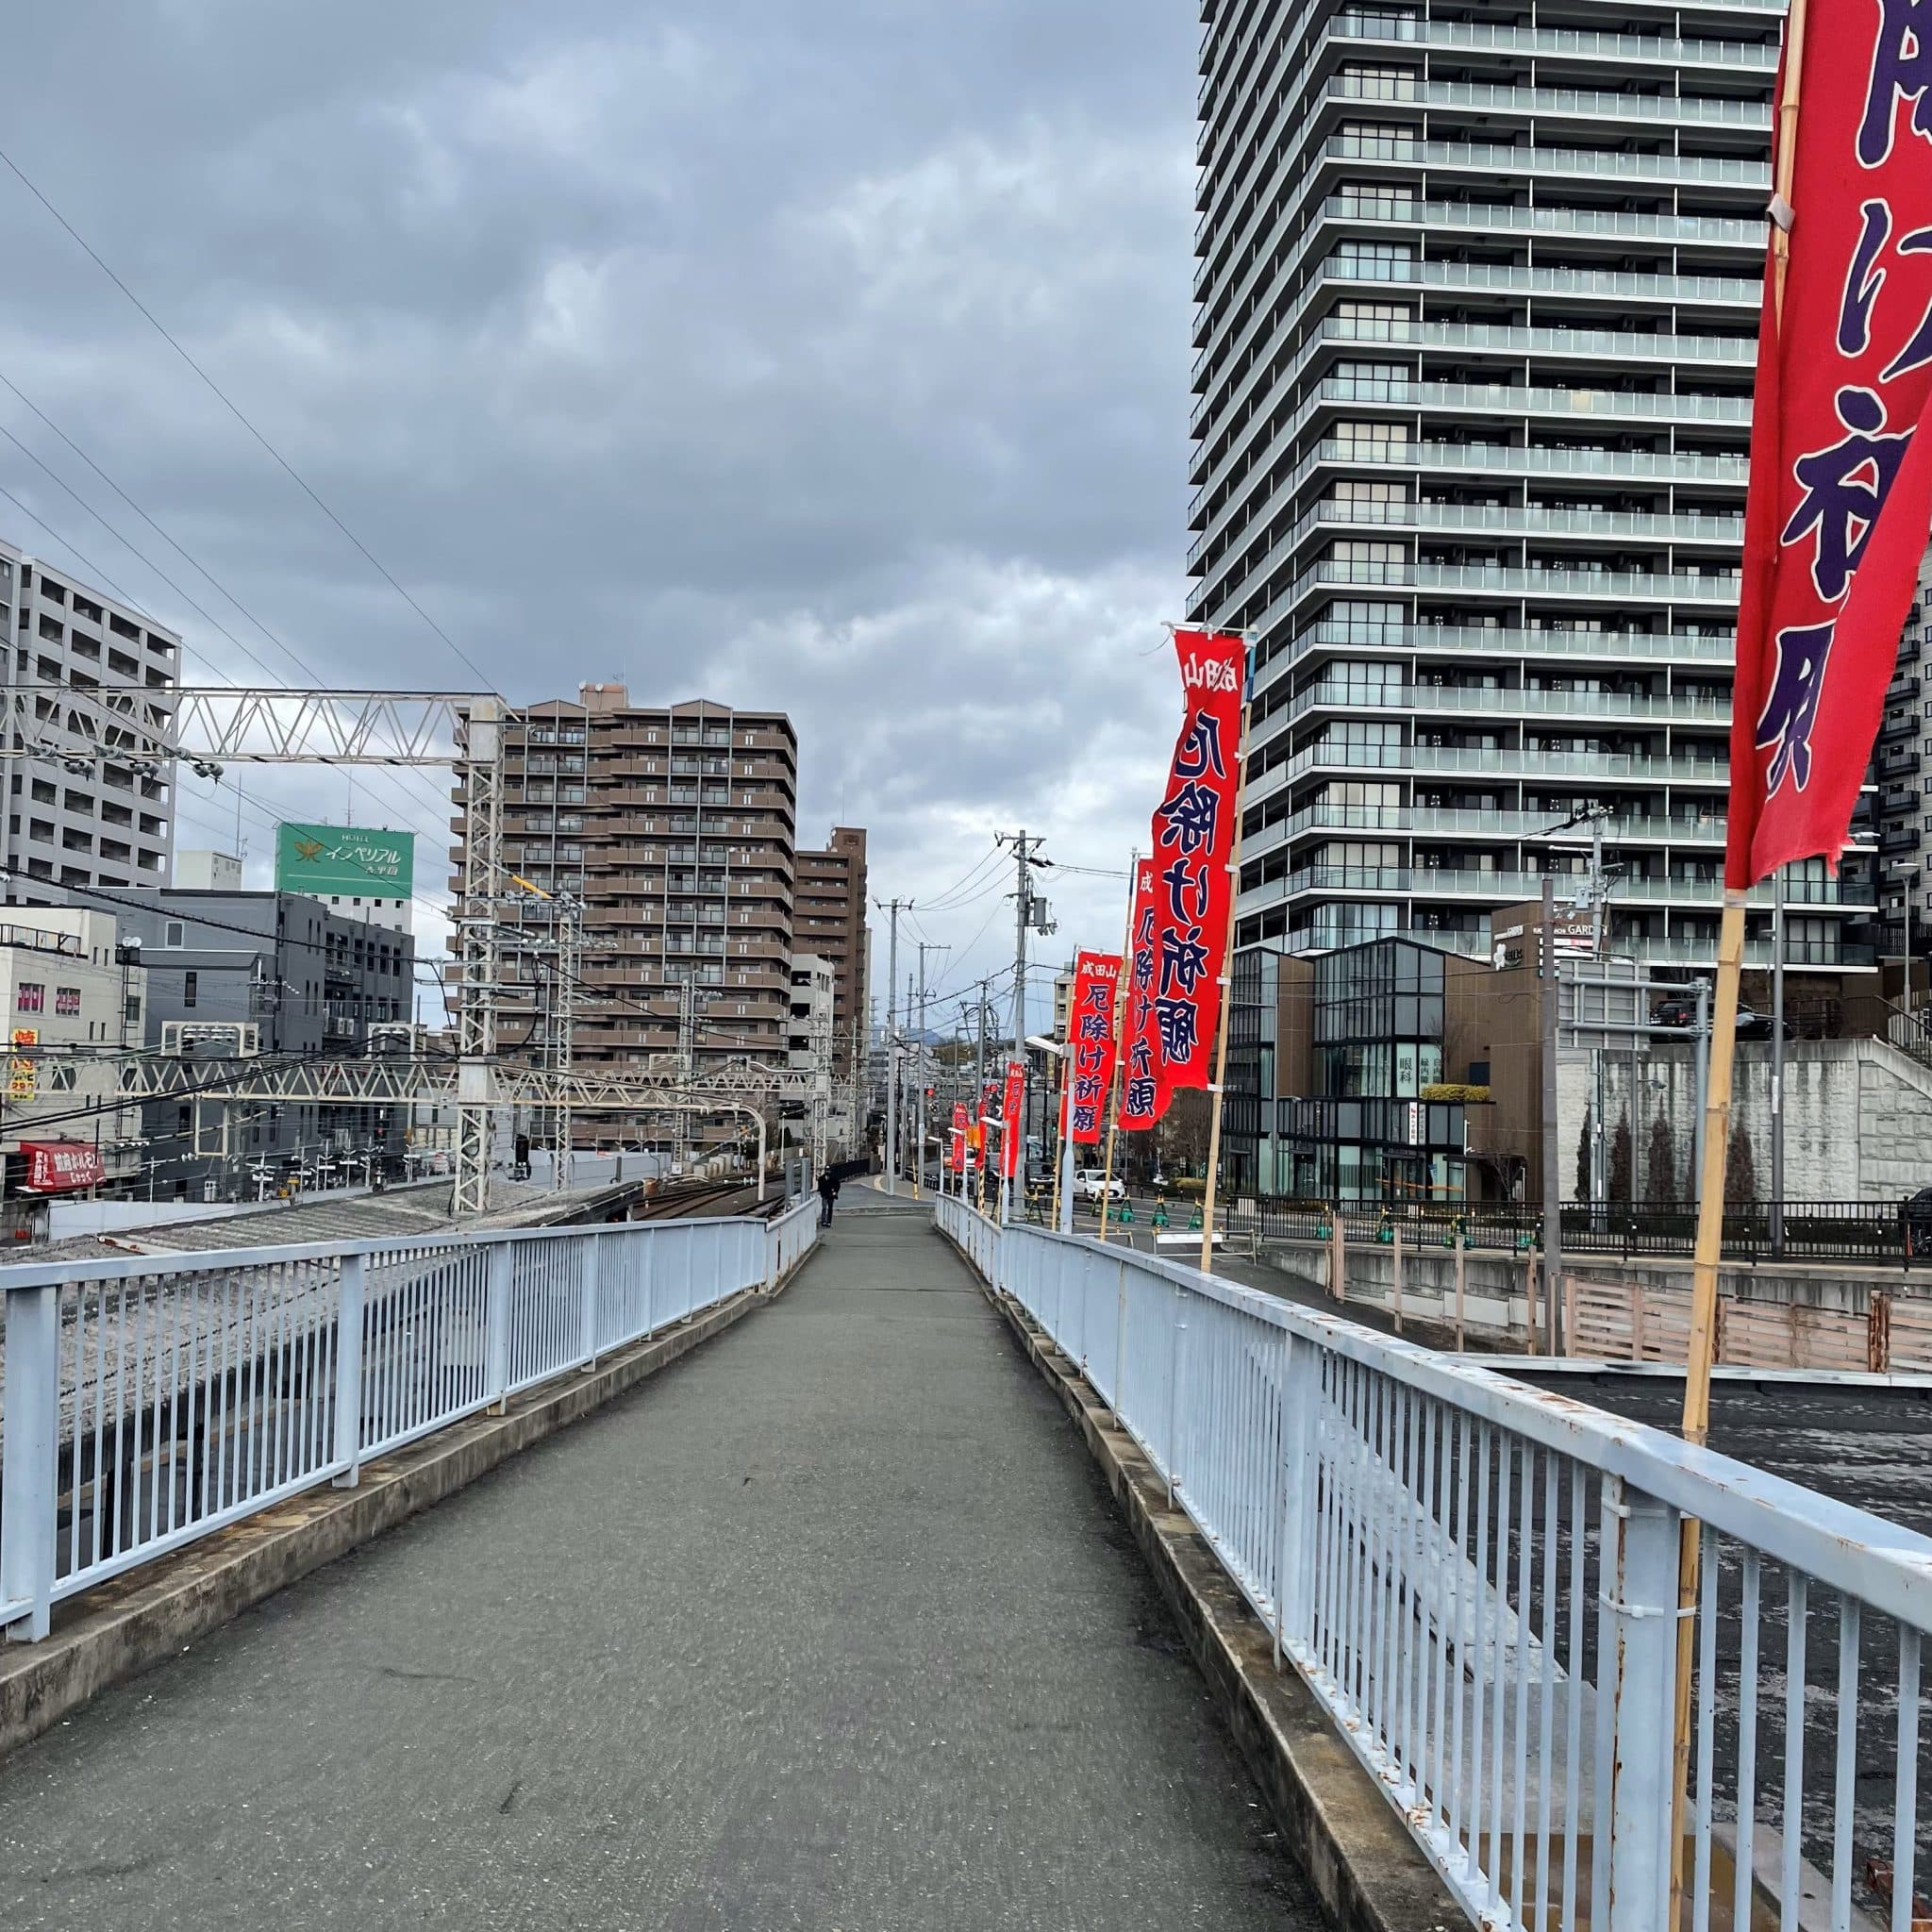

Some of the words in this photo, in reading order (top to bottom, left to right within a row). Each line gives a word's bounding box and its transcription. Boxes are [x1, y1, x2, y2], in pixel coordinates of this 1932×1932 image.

[325, 846, 401, 864] インペリアル
[1568, 924, 1607, 936] GARDN
[1081, 961, 1117, 978] 成田山
[1074, 983, 1109, 1132] 厄除け祈願
[1399, 1057, 1412, 1084] 眼科
